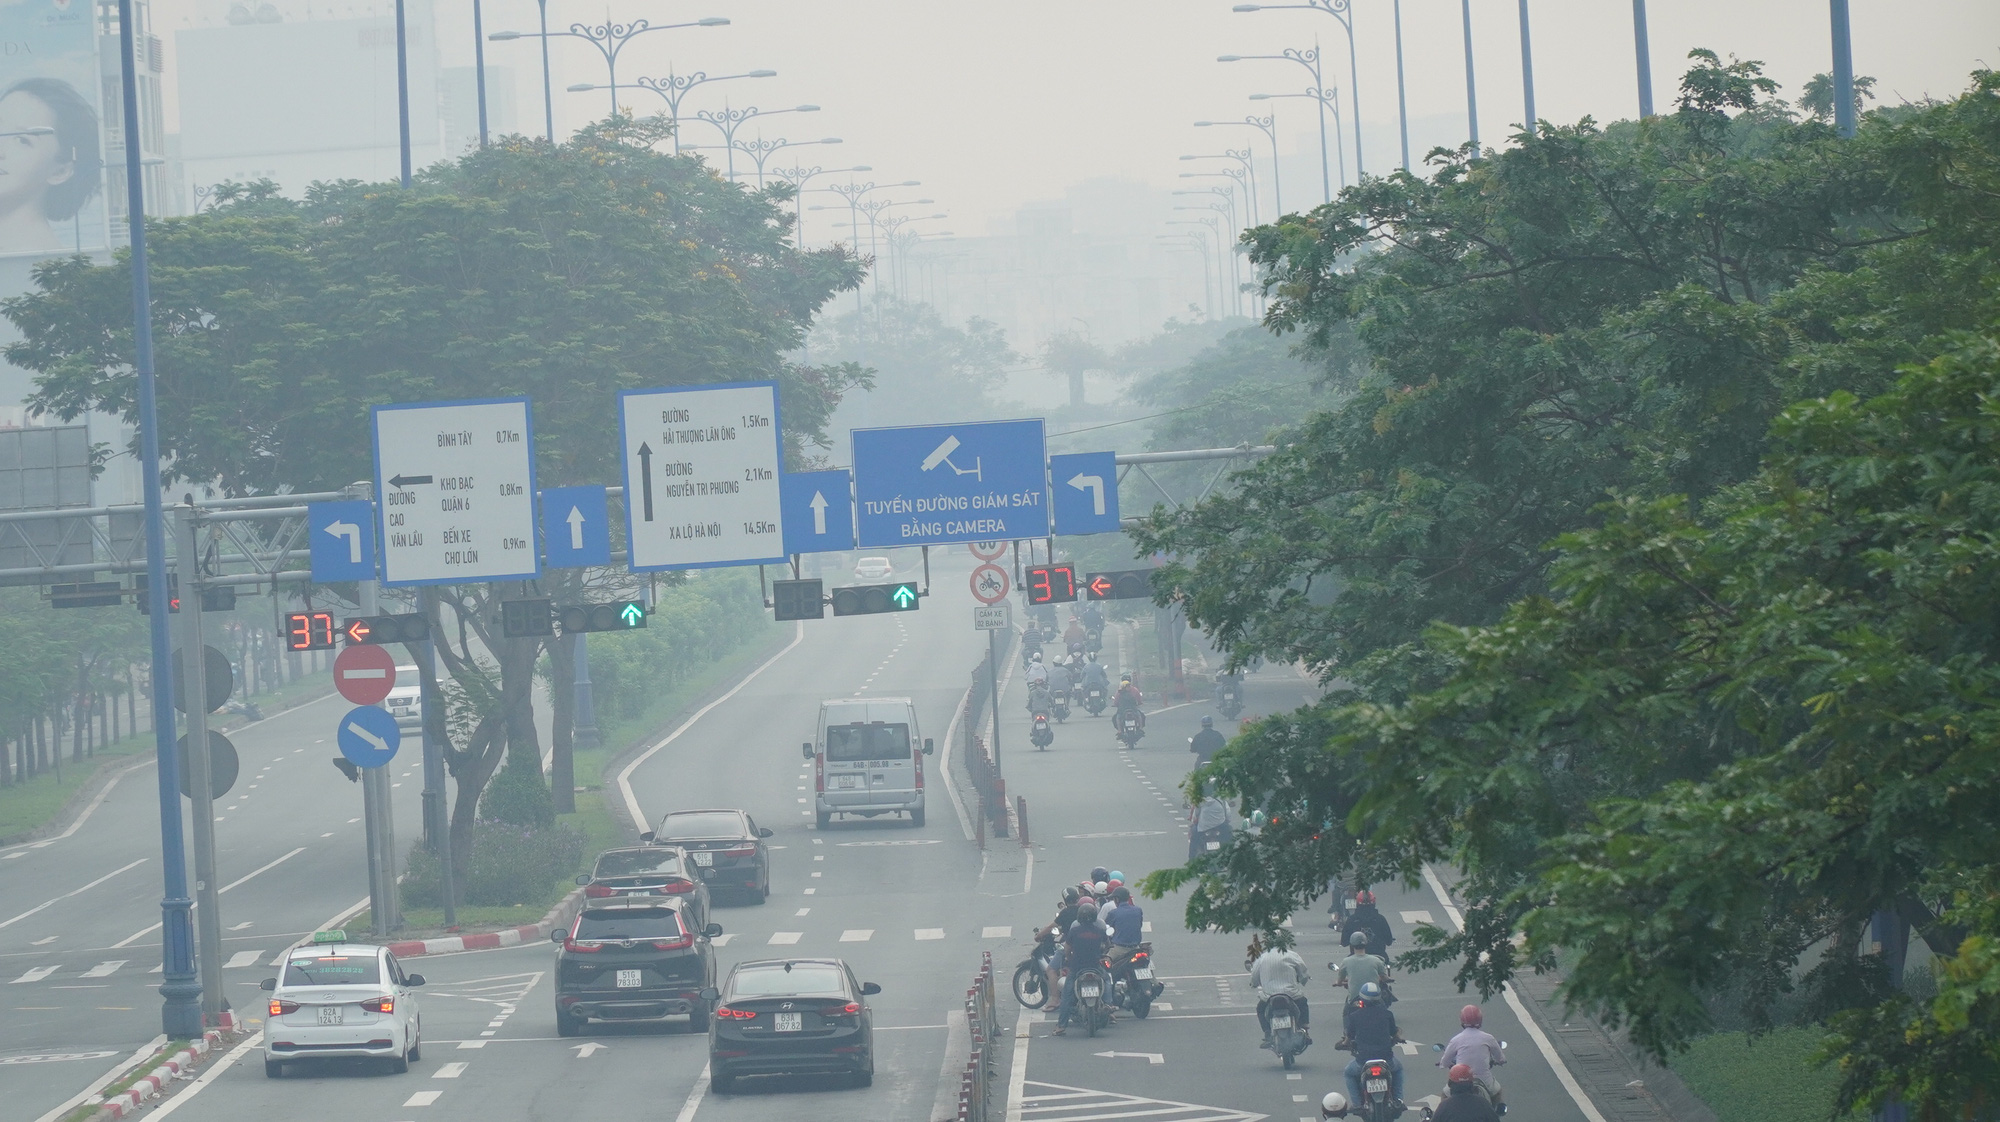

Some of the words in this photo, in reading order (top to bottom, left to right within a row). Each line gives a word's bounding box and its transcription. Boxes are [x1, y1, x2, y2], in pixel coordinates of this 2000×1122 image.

[662, 407, 689, 423] ĐƯỜNG
[438, 431, 456, 447] BÌNH
[458, 430, 472, 446] TÂY
[663, 428, 674, 444] HẢI
[676, 429, 704, 445] THƯỢNG
[721, 426, 736, 441] ÔNG
[666, 460, 693, 476] ĐƯỜNG
[440, 478, 456, 491] KHO
[459, 476, 474, 492] BẠC
[666, 480, 695, 498] NGUYỄN
[697, 482, 708, 495] TRI
[710, 480, 739, 494] PHƯƠNG
[389, 489, 416, 506] ĐƯỜNG
[441, 496, 463, 513] QUẬN
[465, 498, 470, 510] 6
[864, 494, 912, 515] TUYẾN
[916, 494, 968, 512] ĐƯỜNG
[972, 491, 1008, 509] GIÁM
[1012, 489, 1040, 507] SÁT
[389, 513, 404, 526] CAO
[901, 517, 942, 538] BẰNG
[946, 519, 1006, 534] CAMERA
[443, 526, 459, 544] BẾN
[461, 530, 471, 543] XE
[670, 526, 680, 540] XA
[683, 523, 692, 541] LỘ
[695, 522, 706, 538] HÀ
[708, 522, 721, 539] NỘI
[445, 551, 460, 566] CHỢ
[463, 547, 478, 563] LỚN
[1032, 567, 1074, 602] 37
[291, 614, 332, 648] 37
[320, 1016, 342, 1024] 124.13
[323, 1008, 336, 1016] 62A
[776, 1022, 801, 1030] 067.82
